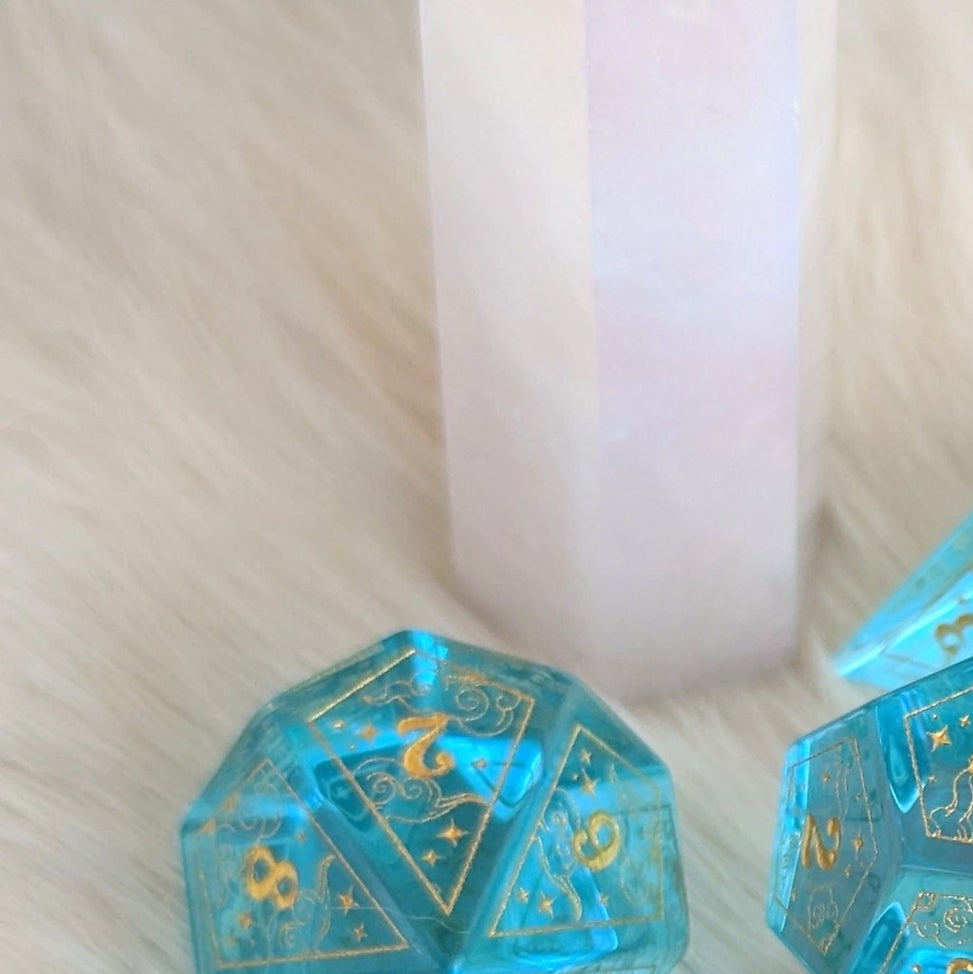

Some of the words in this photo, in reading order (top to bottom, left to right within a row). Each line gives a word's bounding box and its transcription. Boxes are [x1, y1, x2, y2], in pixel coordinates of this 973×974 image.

[398, 713, 455, 780] 2
[802, 812, 841, 871] 2
[245, 844, 298, 909] 8
